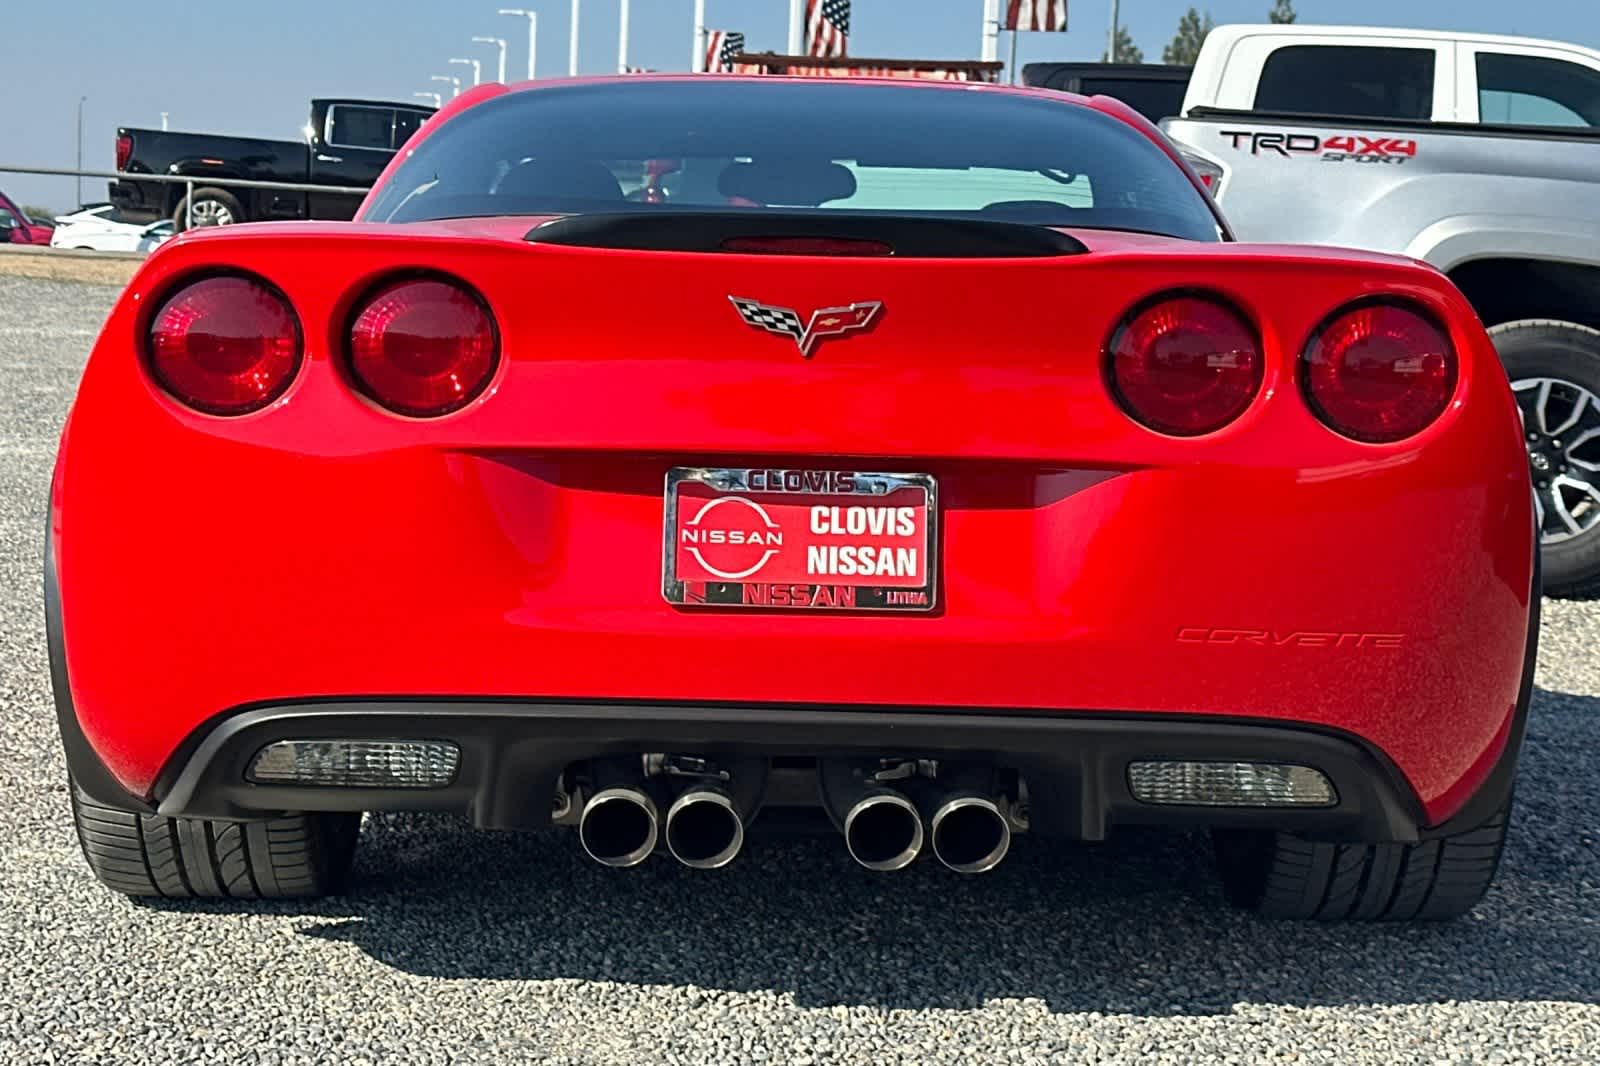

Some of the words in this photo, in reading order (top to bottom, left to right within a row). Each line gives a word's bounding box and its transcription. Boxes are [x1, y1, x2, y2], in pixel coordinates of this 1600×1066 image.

[1219, 131, 1320, 156] TRD
[1320, 153, 1409, 164] SPORT
[747, 470, 856, 493] CLOVIS
[810, 506, 916, 535] CLOVIS
[681, 529, 783, 545] NISSAN
[807, 546, 917, 576] NISSAN
[742, 583, 856, 608] NISSAN
[1176, 628, 1407, 648] CORVETTE
